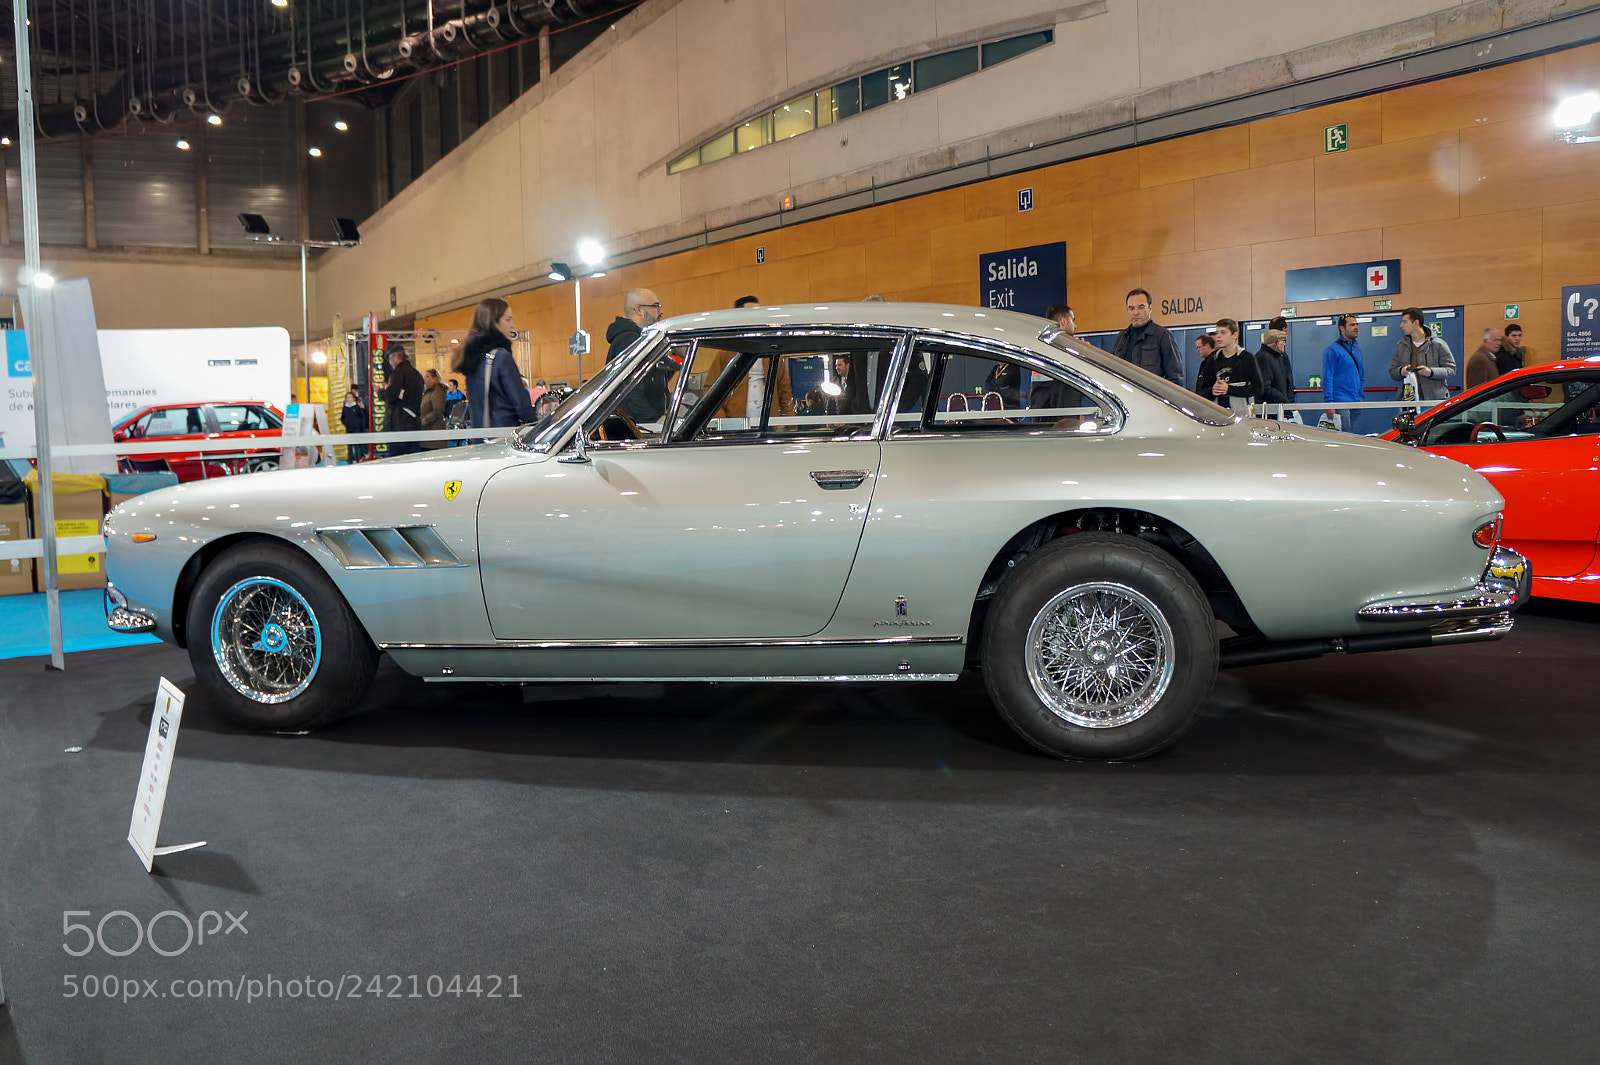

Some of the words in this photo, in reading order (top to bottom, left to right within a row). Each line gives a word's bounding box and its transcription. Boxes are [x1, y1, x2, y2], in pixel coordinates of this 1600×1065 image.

[988, 256, 1038, 282] Salida
[989, 288, 1015, 309] Exit
[1161, 297, 1204, 316] SALIDA
[106, 387, 157, 397] emanales
[9, 401, 23, 411] de
